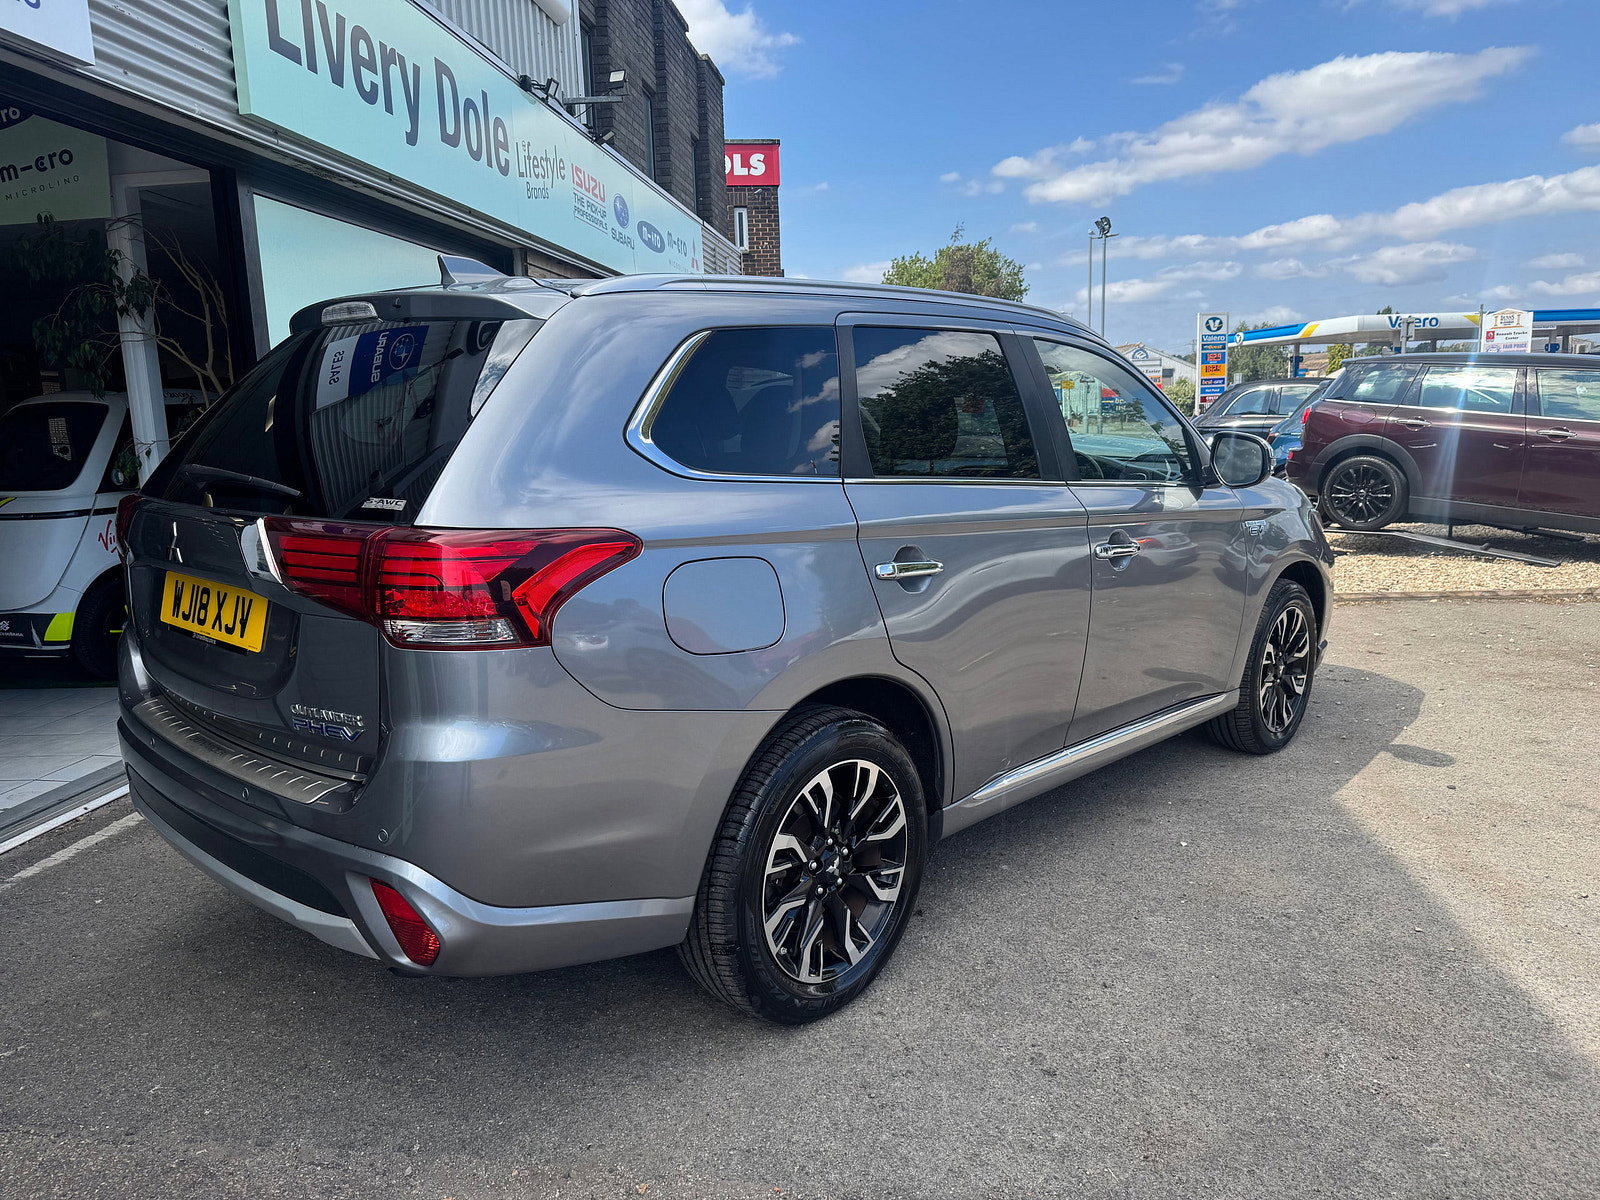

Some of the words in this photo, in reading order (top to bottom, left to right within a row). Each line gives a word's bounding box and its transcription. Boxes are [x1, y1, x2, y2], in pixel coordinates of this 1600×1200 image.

[264, 0, 421, 147] Livery
[434, 56, 510, 177] Dole
[516, 140, 565, 189] Lifestyle
[5, 175, 79, 201] MICROLINO
[526, 181, 549, 200] Brands
[571, 163, 606, 203] ISUZU
[573, 192, 585, 208] THE
[574, 205, 608, 231] PROFESSIONALS
[611, 228, 635, 251] SUBARU
[1388, 315, 1439, 329] Vero
[172, 580, 211, 627] WJ18
[211, 591, 254, 639] XJV
[290, 704, 364, 727] OUTLANDER
[292, 718, 366, 742] PHEV
